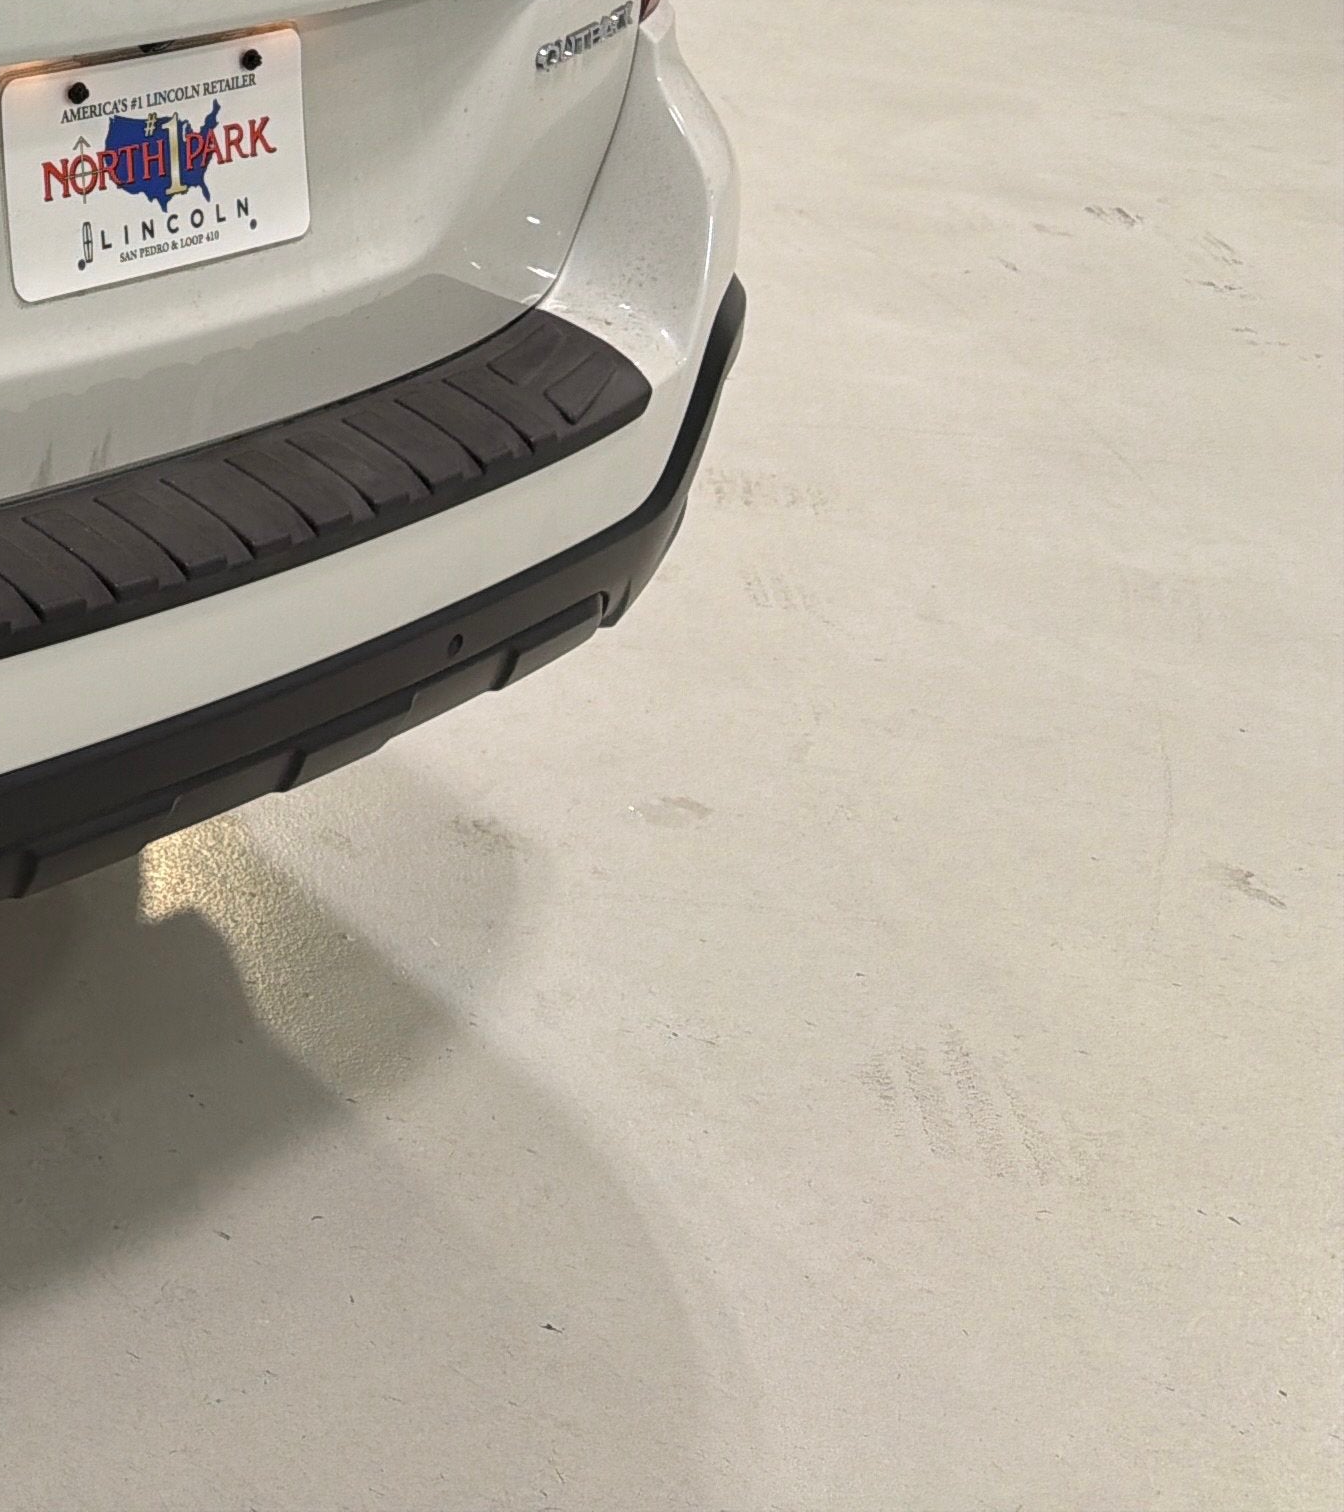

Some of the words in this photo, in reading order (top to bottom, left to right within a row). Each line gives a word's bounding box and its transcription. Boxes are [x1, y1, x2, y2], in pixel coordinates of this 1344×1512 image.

[61, 98, 128, 124] AMERICA'S
[130, 97, 143, 110] #1
[146, 84, 200, 107] LINCOLN
[202, 73, 256, 97] RETAILER
[41, 139, 167, 202] NORTH
[184, 116, 277, 171] PARK
[100, 197, 249, 250] LINCOLN
[119, 248, 138, 263] SAN
[139, 241, 170, 259] PEDRO
[171, 240, 179, 251] &
[180, 233, 204, 248] LOOP
[205, 230, 220, 242] 410
